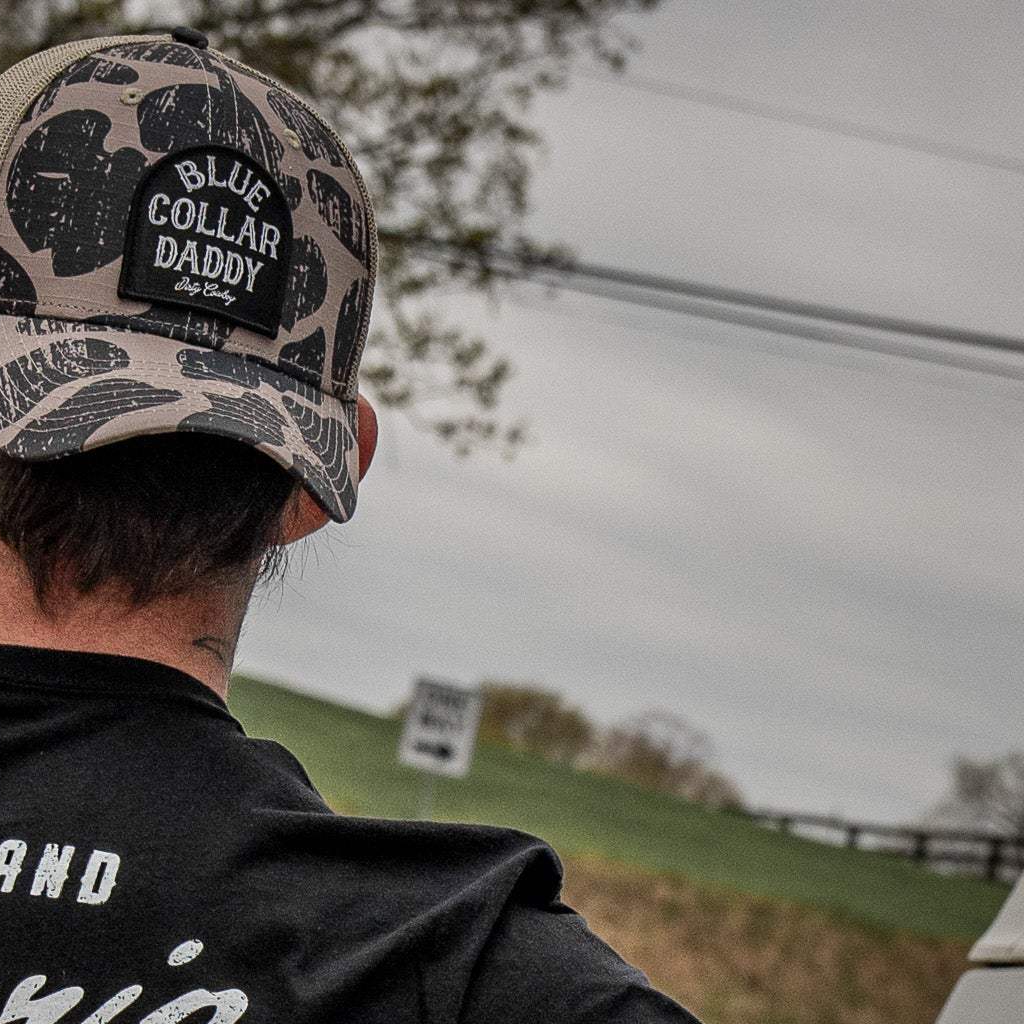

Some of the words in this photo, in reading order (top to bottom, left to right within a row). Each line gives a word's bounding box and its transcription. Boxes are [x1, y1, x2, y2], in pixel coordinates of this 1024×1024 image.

[175, 155, 270, 212] BLUE
[148, 193, 280, 260] COLLAR
[153, 235, 264, 292] DADDY
